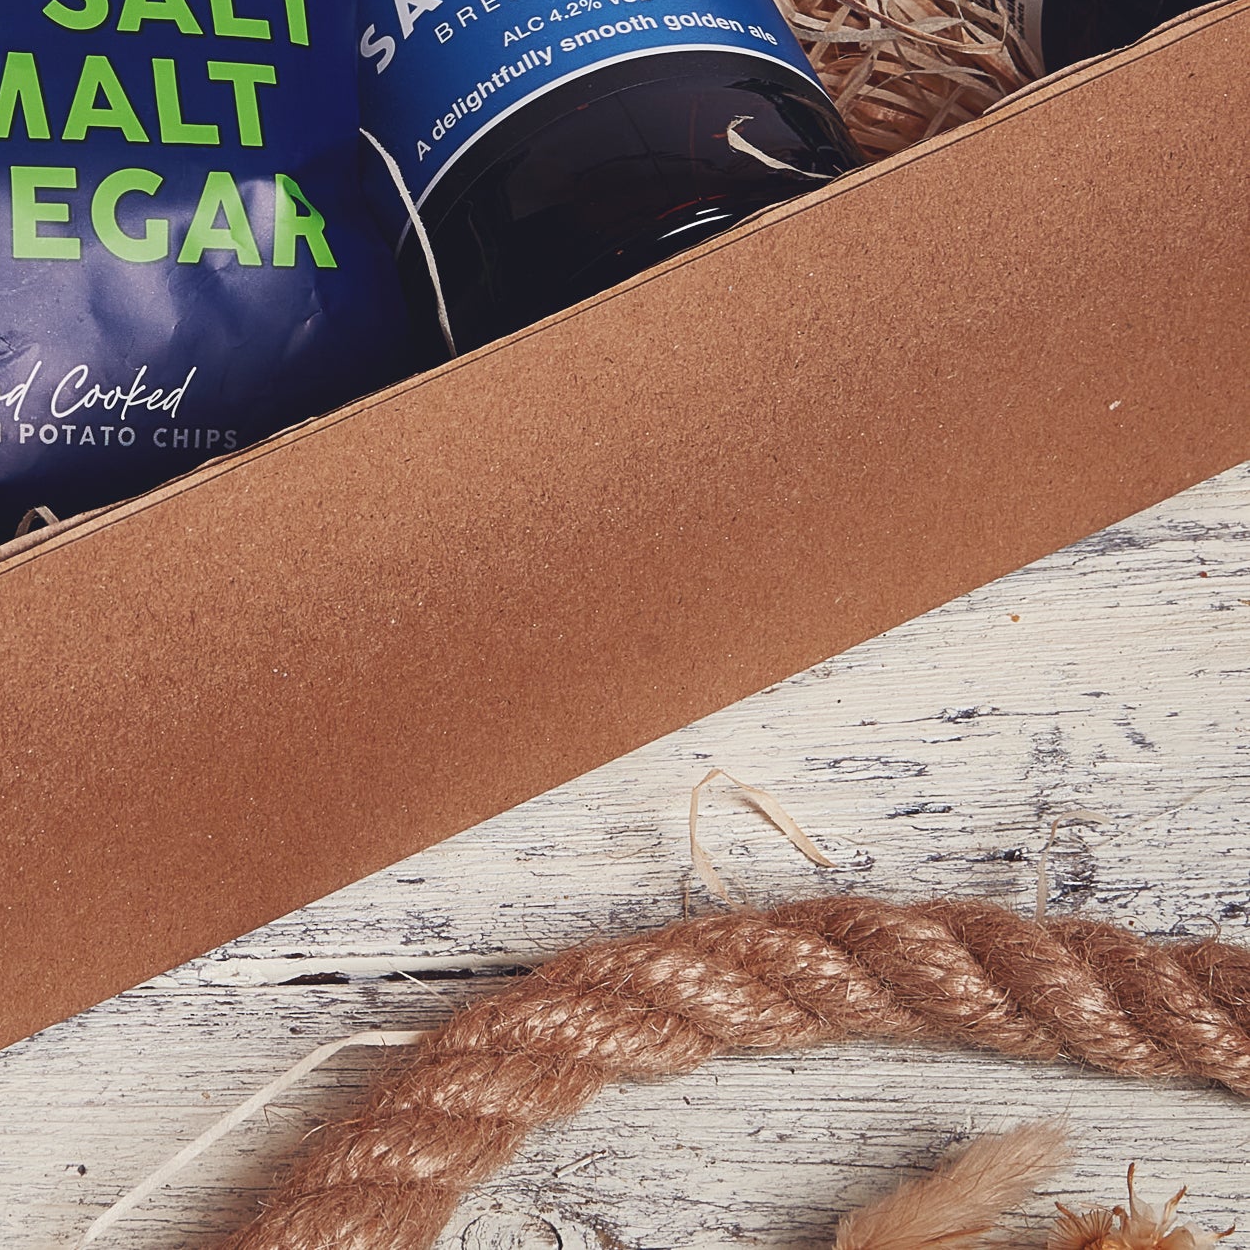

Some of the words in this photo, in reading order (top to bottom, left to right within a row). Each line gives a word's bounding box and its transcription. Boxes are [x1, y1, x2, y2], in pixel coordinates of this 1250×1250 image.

[503, 15, 545, 47] ALC
[416, 140, 432, 162] A
[431, 45, 554, 142] delightfully
[560, 14, 658, 53] smooth
[664, 11, 745, 36] golden
[750, 25, 779, 47] ale
[50, 364, 198, 420] Cooked
[19, 423, 137, 447] POTATO
[153, 427, 239, 450] CHIPS
